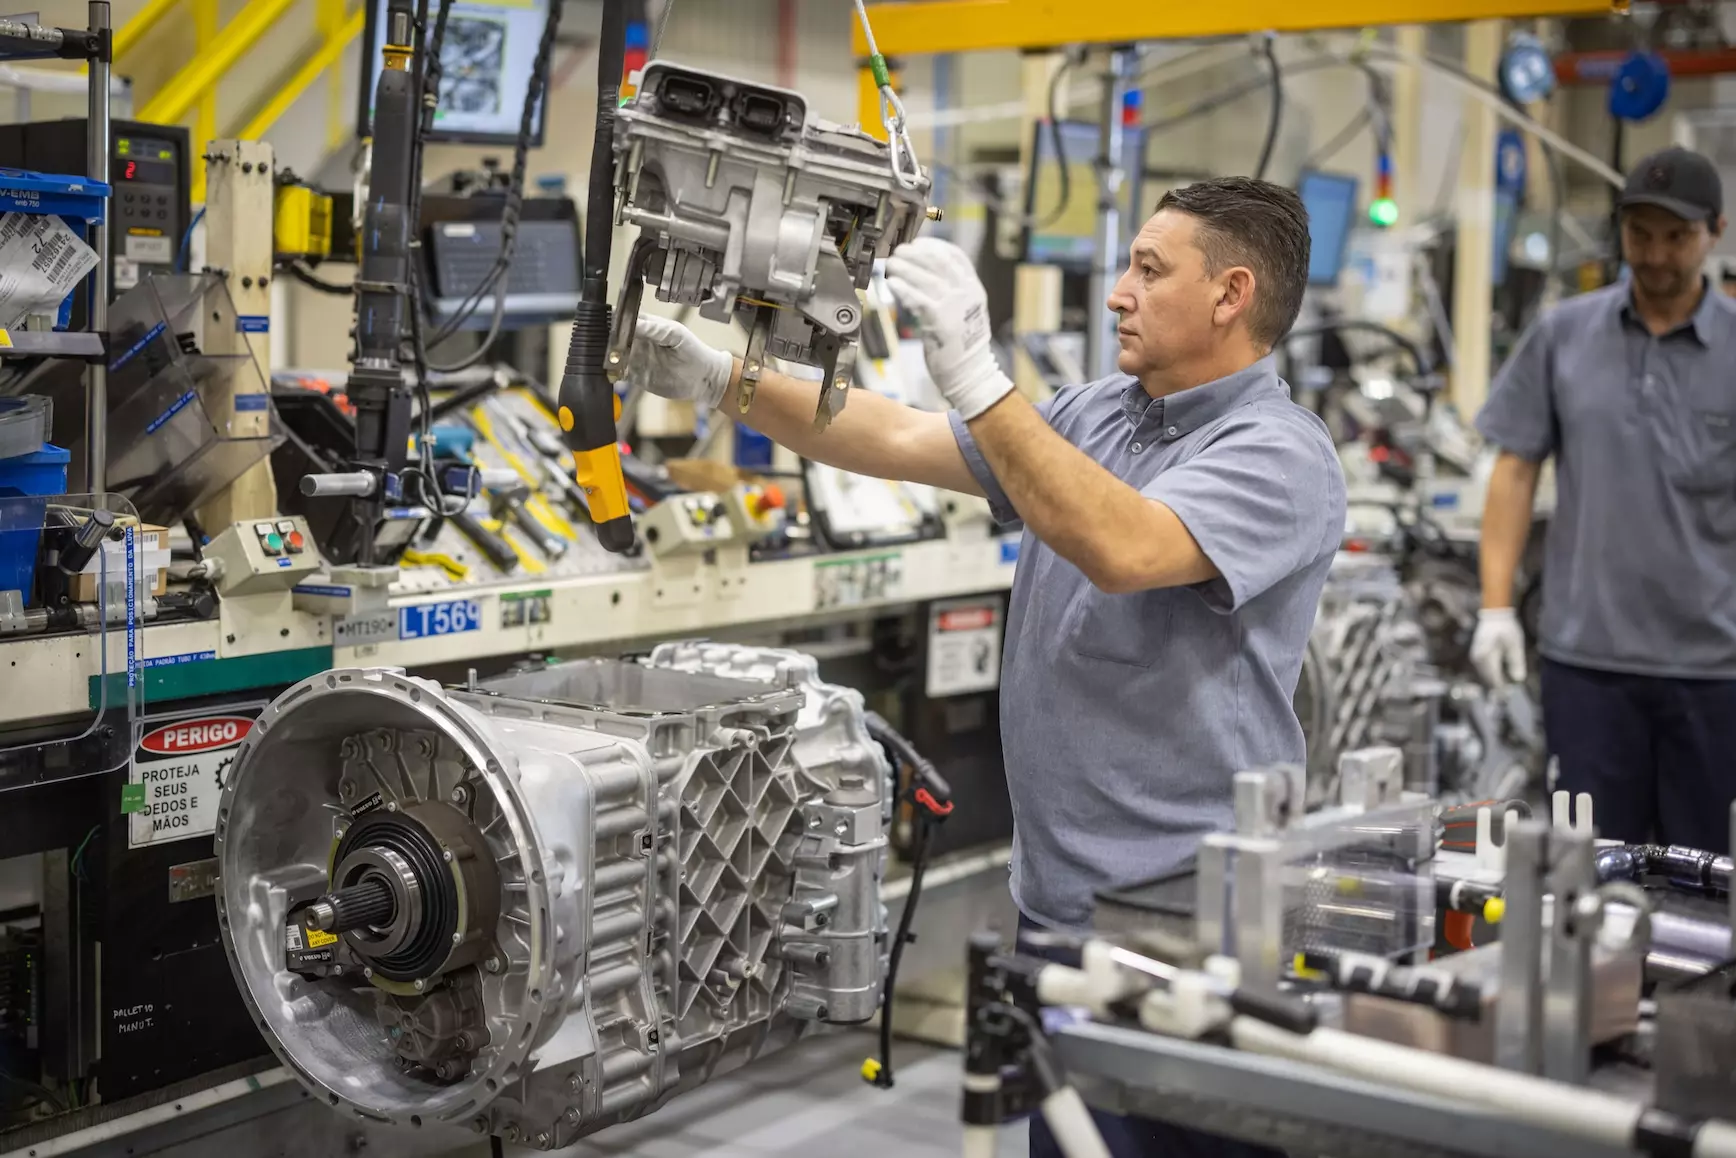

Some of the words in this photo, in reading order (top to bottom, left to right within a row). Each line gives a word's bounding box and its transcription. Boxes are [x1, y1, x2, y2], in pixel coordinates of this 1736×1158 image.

[28, 200, 40, 208] 750
[31, 238, 48, 254] 72
[127, 550, 133, 559] DA
[155, 655, 176, 667] PADRÃO
[163, 721, 238, 749] PERIGO
[142, 764, 200, 783] PROTEJA
[154, 782, 188, 798] SEUS
[143, 798, 187, 816] DEDOS
[190, 796, 198, 808] E
[152, 814, 189, 832] MÃOS
